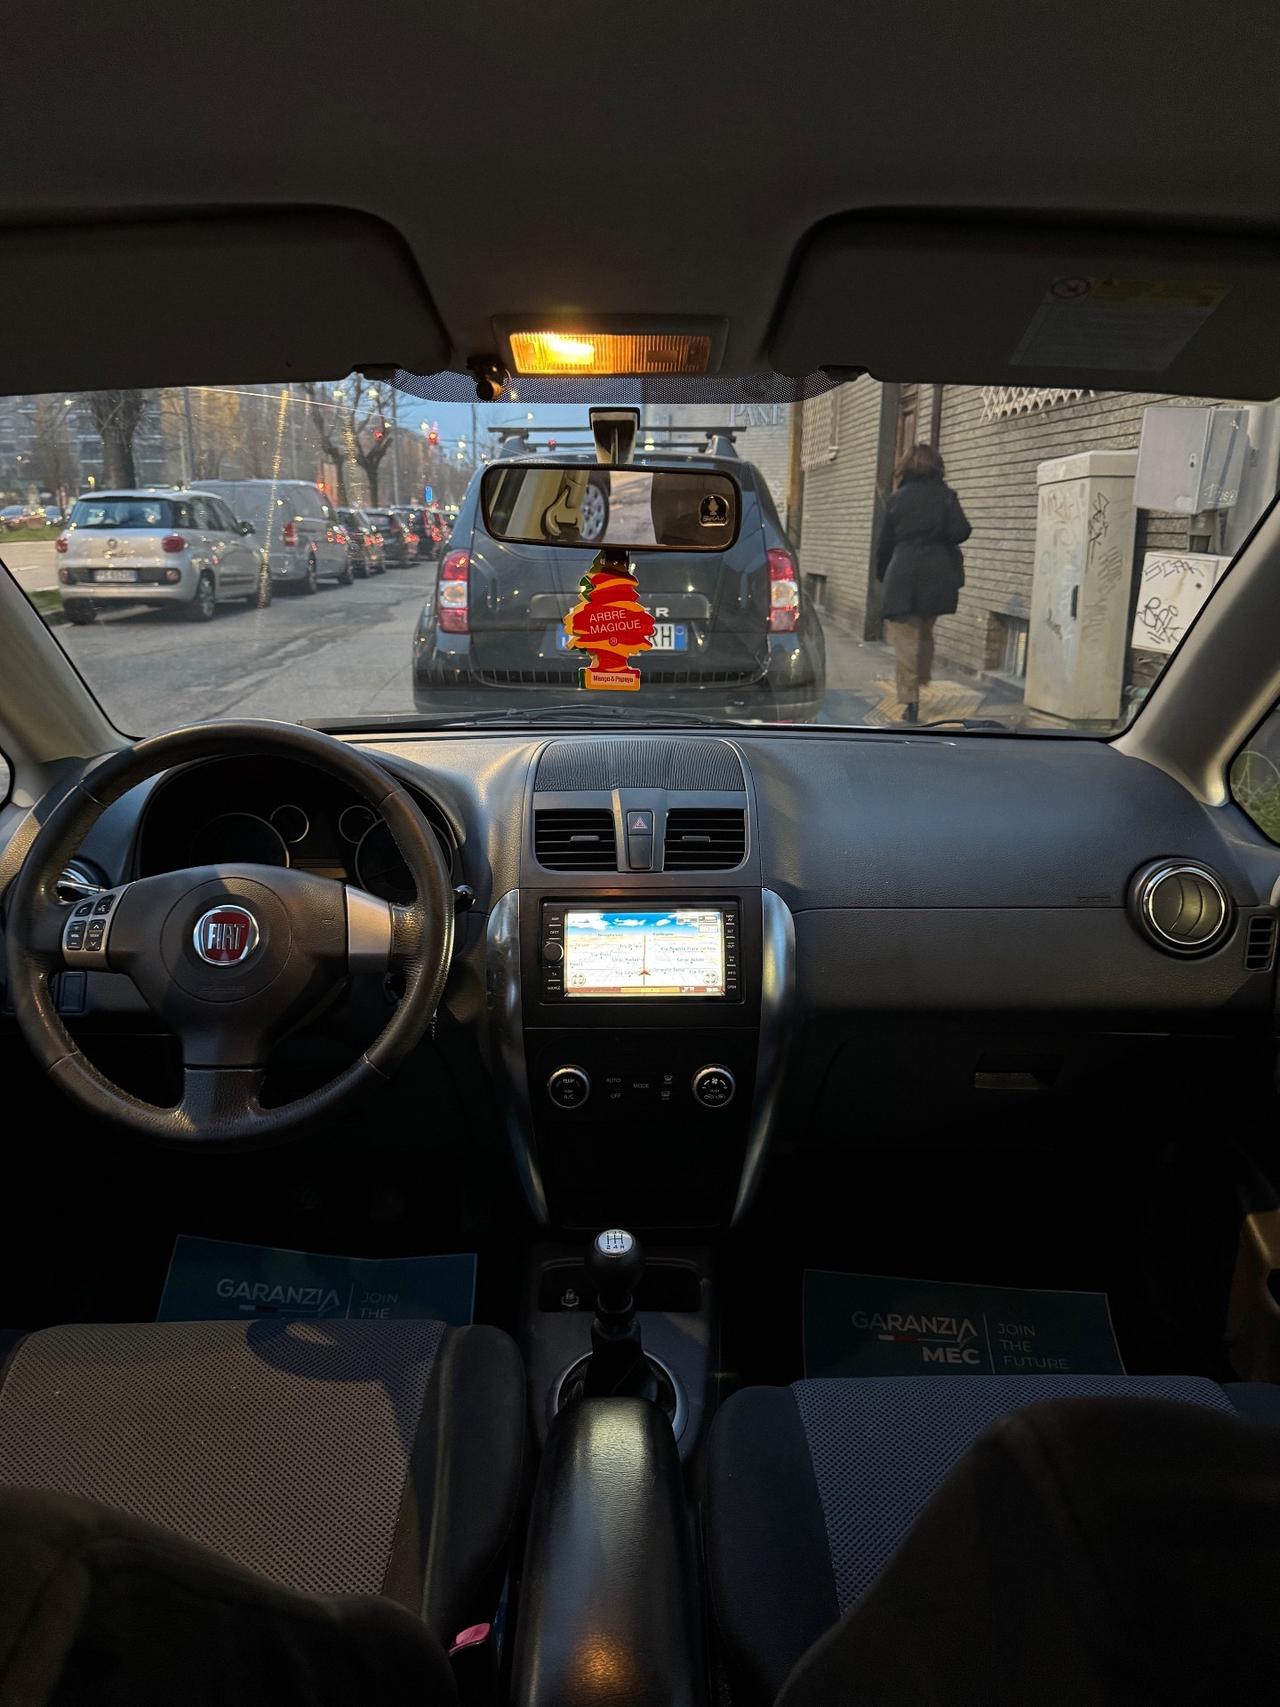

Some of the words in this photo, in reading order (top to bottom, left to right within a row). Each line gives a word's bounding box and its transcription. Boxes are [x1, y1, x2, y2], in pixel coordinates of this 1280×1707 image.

[590, 609, 626, 623] ARBRE
[590, 619, 641, 634] MAGIQUE
[615, 676, 634, 684] Papaya
[208, 923, 245, 950] FIAT
[216, 1278, 341, 1312] GARANZIA
[361, 1290, 398, 1304] JOIN
[359, 1307, 390, 1320] THE
[851, 1310, 978, 1343] GARANZIA
[998, 1322, 1036, 1337] JOIN
[1000, 1339, 1032, 1353] THE
[922, 1346, 981, 1364] MEC
[1003, 1355, 1070, 1370] FUTURE
